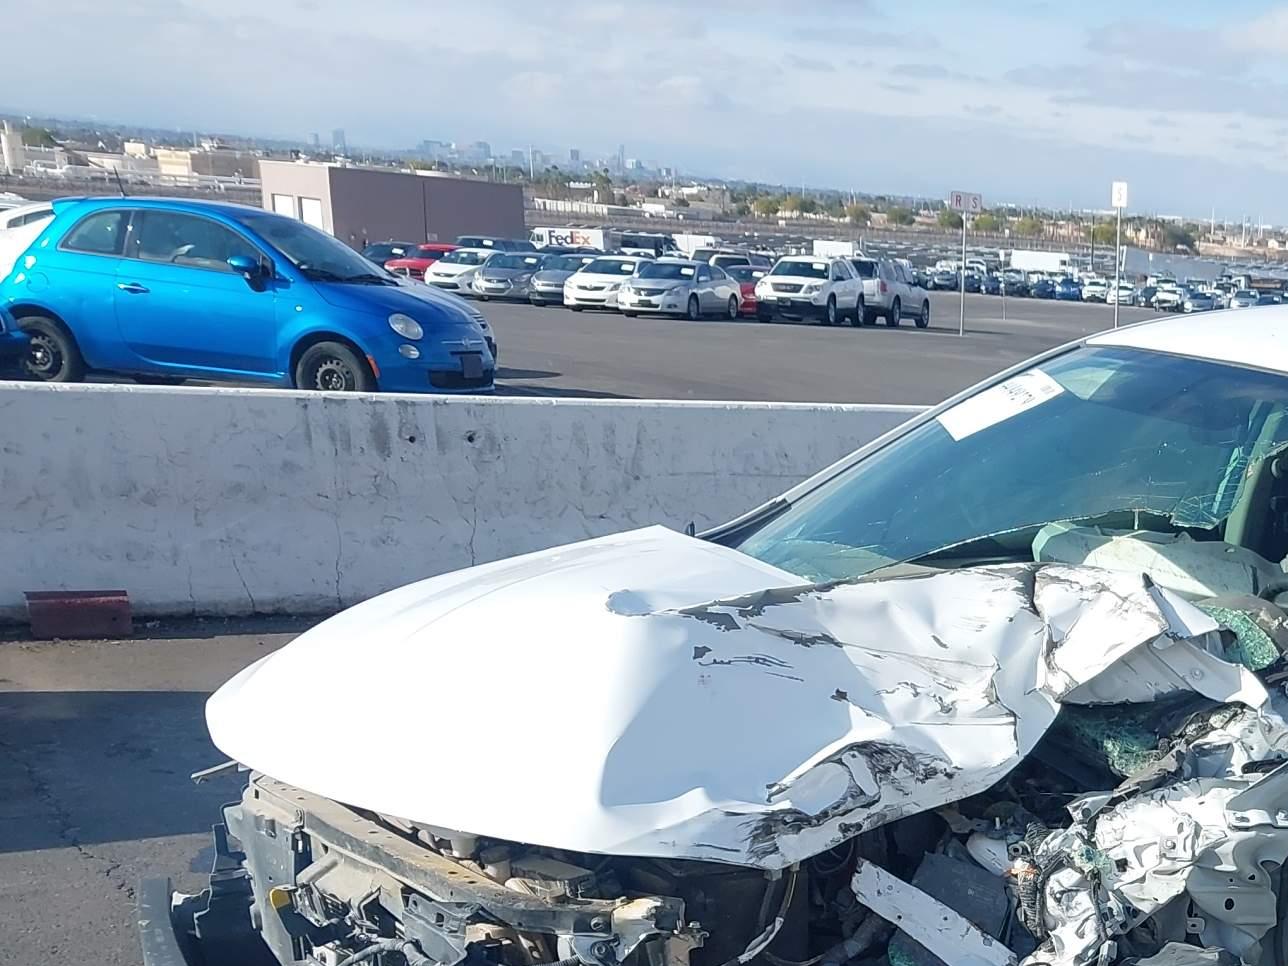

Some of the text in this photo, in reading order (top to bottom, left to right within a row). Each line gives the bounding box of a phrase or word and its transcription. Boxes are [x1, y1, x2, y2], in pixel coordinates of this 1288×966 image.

[955, 194, 978, 209] R S
[548, 229, 591, 246] FedEx
